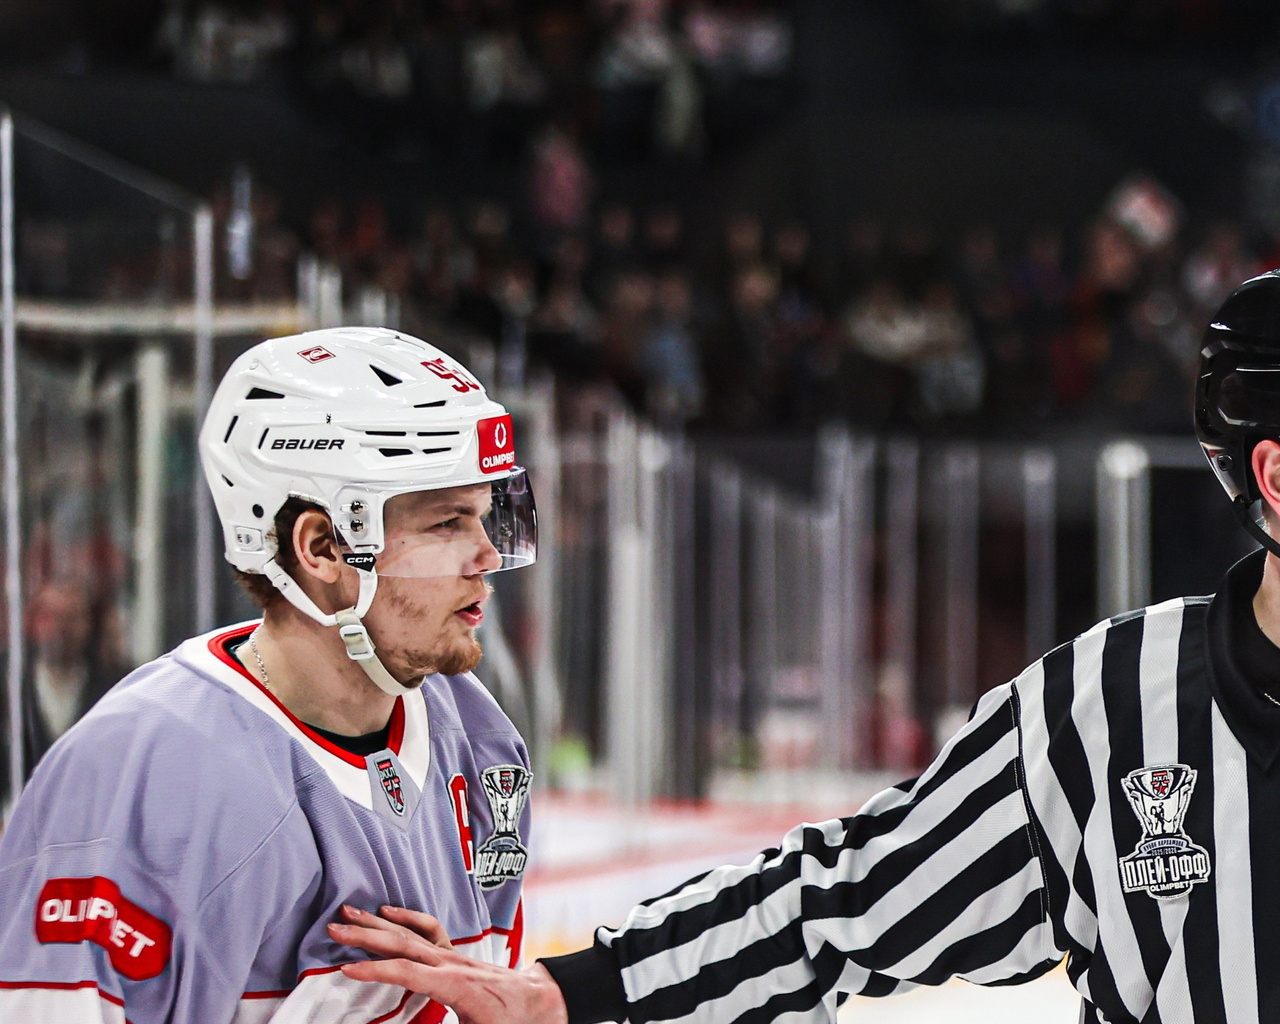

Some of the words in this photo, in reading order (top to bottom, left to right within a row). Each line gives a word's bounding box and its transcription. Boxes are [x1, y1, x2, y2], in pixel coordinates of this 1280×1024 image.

[346, 556, 374, 564] CCM
[1125, 853, 1207, 888] ПЛЕЙ-ОФФ
[1150, 880, 1189, 892] OLIMPBET
[41, 896, 156, 958] OLIPET
